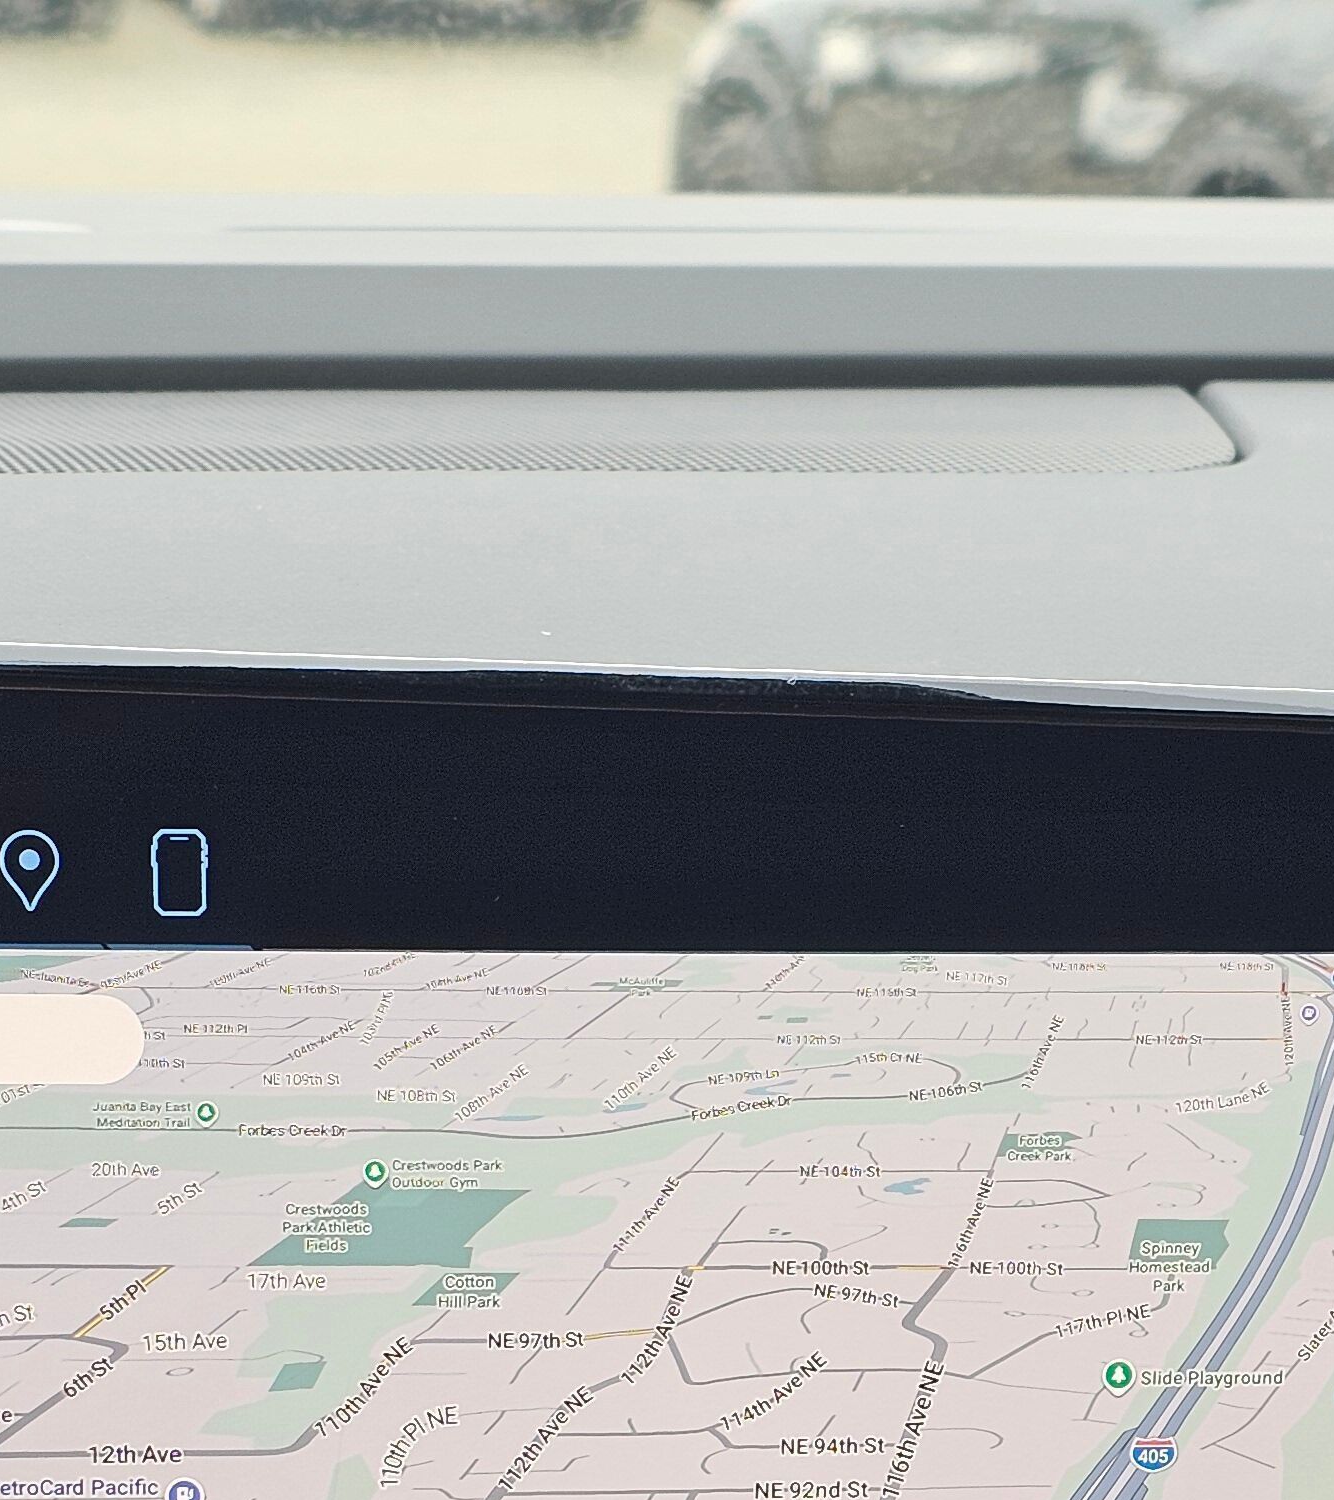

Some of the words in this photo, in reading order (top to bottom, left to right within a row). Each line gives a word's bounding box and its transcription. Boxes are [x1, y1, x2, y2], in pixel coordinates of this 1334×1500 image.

[393, 1160, 468, 1172] Crestwoods
[473, 1160, 502, 1172] Park
[393, 1177, 444, 1188] Outdoor
[450, 1177, 477, 1191] Gym
[286, 1204, 367, 1215] Crestwoods
[283, 1223, 312, 1233] Park
[318, 1222, 370, 1233] Athletic
[306, 1239, 347, 1251] Fields
[1142, 1243, 1198, 1256] Spinney
[773, 1262, 796, 1275] NE
[802, 1262, 848, 1275] 100th
[854, 1262, 869, 1275] St
[1130, 1262, 1209, 1274] Homestead
[248, 1275, 289, 1288] 17th
[293, 1274, 326, 1288] Ave
[445, 1276, 494, 1288] Cotton
[1153, 1281, 1184, 1292] Park
[439, 1296, 462, 1308] Hill
[469, 1296, 500, 1308] Park
[1056, 1315, 1104, 1337] 117th
[1108, 1310, 1125, 1325] Pl
[1127, 1304, 1150, 1321] NE
[489, 1334, 514, 1348] NE
[519, 1332, 561, 1349] 97th
[566, 1333, 583, 1347] St
[63, 1371, 91, 1397] 6th
[92, 1357, 113, 1379] St
[1141, 1371, 1181, 1385] Slide
[1189, 1371, 1282, 1387] Playground
[781, 1439, 808, 1454] NE
[816, 1438, 858, 1454] 94th
[865, 1438, 884, 1453] St
[90, 1447, 136, 1463] 12th
[143, 1447, 182, 1463] Ave
[1138, 1449, 1169, 1463] 405
[92, 1479, 158, 1496] Pacific
[755, 1484, 782, 1498] NE
[790, 1483, 840, 1498] 92nd
[847, 1483, 868, 1498] St
